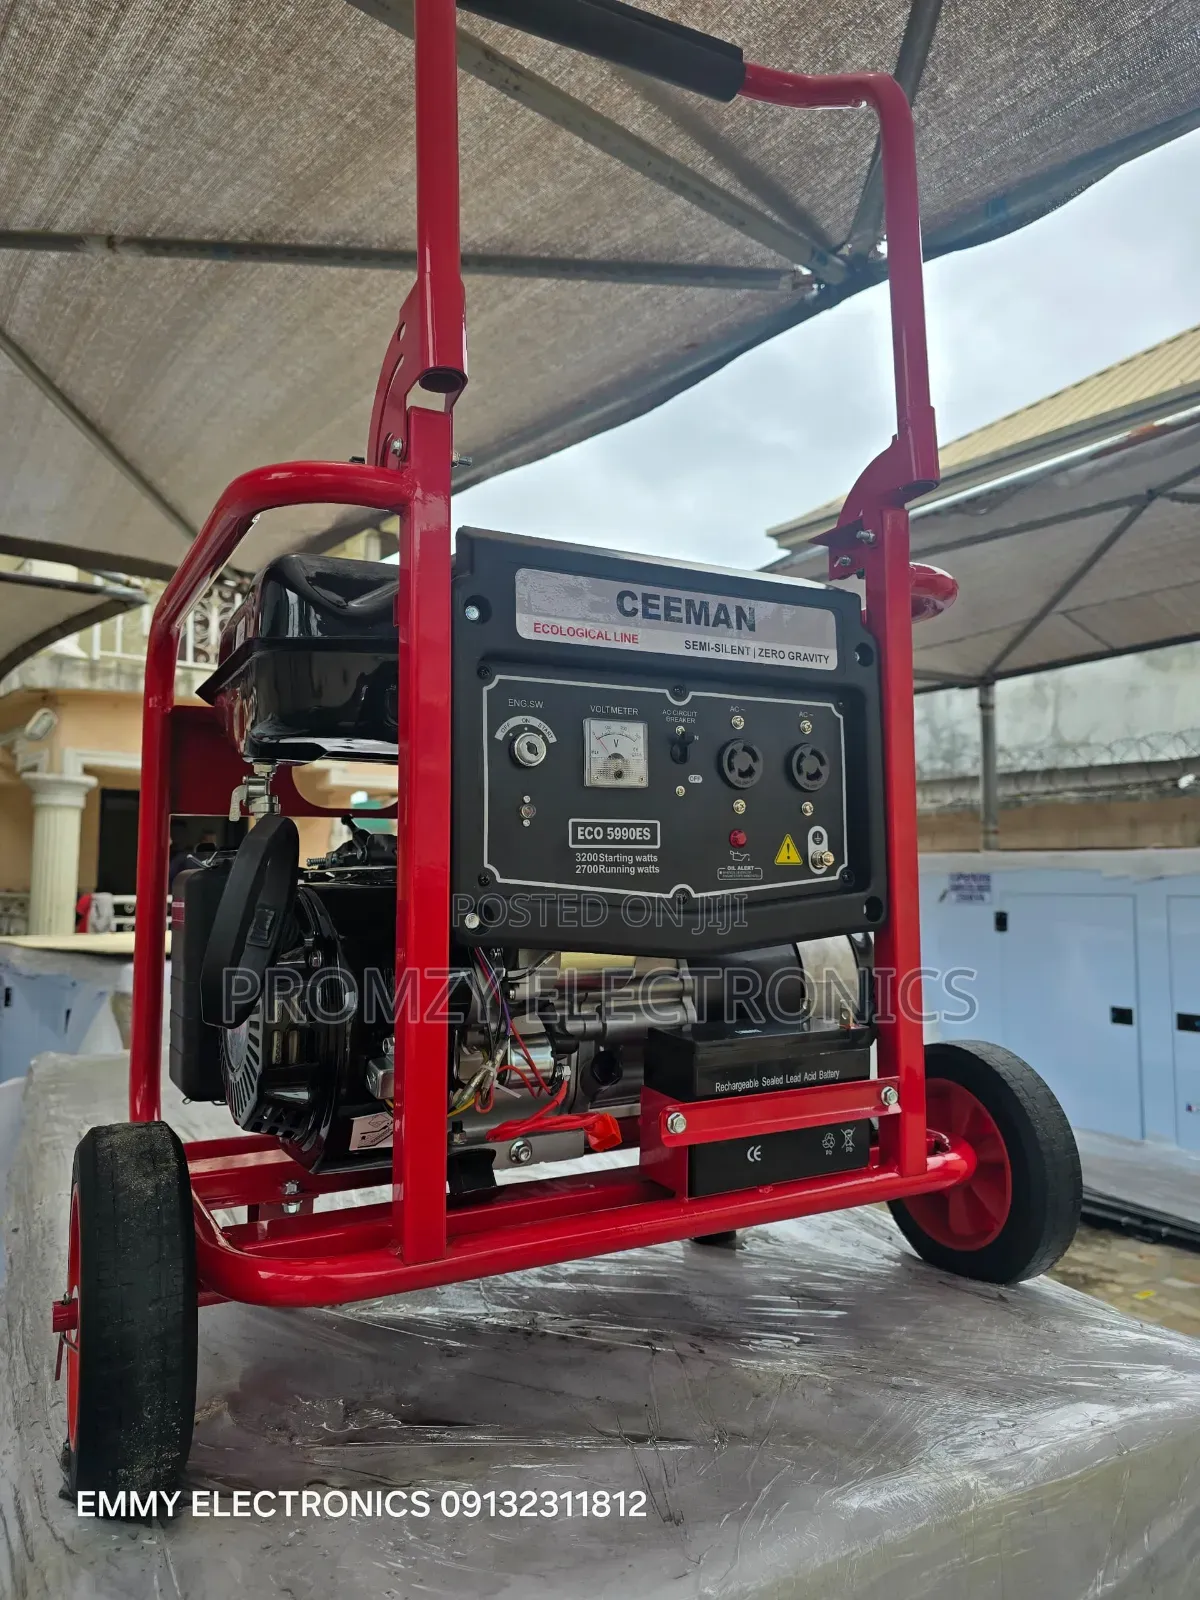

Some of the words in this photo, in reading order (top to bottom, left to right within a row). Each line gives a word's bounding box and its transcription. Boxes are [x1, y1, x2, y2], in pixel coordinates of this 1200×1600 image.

[616, 590, 756, 632] CEEMAN
[533, 622, 612, 642] ECOLOGICAL
[614, 632, 639, 644] LINE
[684, 640, 751, 656] SEMI-SILENT
[758, 648, 786, 660] ZERO
[788, 651, 830, 664] GRAVITY
[590, 704, 639, 716] VOLTMETER
[665, 716, 696, 724] BREAKER
[537, 722, 554, 739] START
[613, 739, 619, 748] V
[577, 826, 604, 840] ECO
[606, 827, 651, 840] 5990ES
[575, 853, 598, 862] 3200
[599, 853, 634, 864] Starting
[635, 854, 658, 862] watts
[575, 865, 598, 874] 2700
[599, 865, 636, 875] Running
[637, 865, 660, 873] watts
[715, 1079, 759, 1092] Rechargeable
[761, 1076, 784, 1087] Sealed
[785, 1073, 802, 1083] Lead
[803, 1071, 817, 1081] Acid
[819, 1069, 840, 1080] Battery
[747, 1145, 762, 1162] CE
